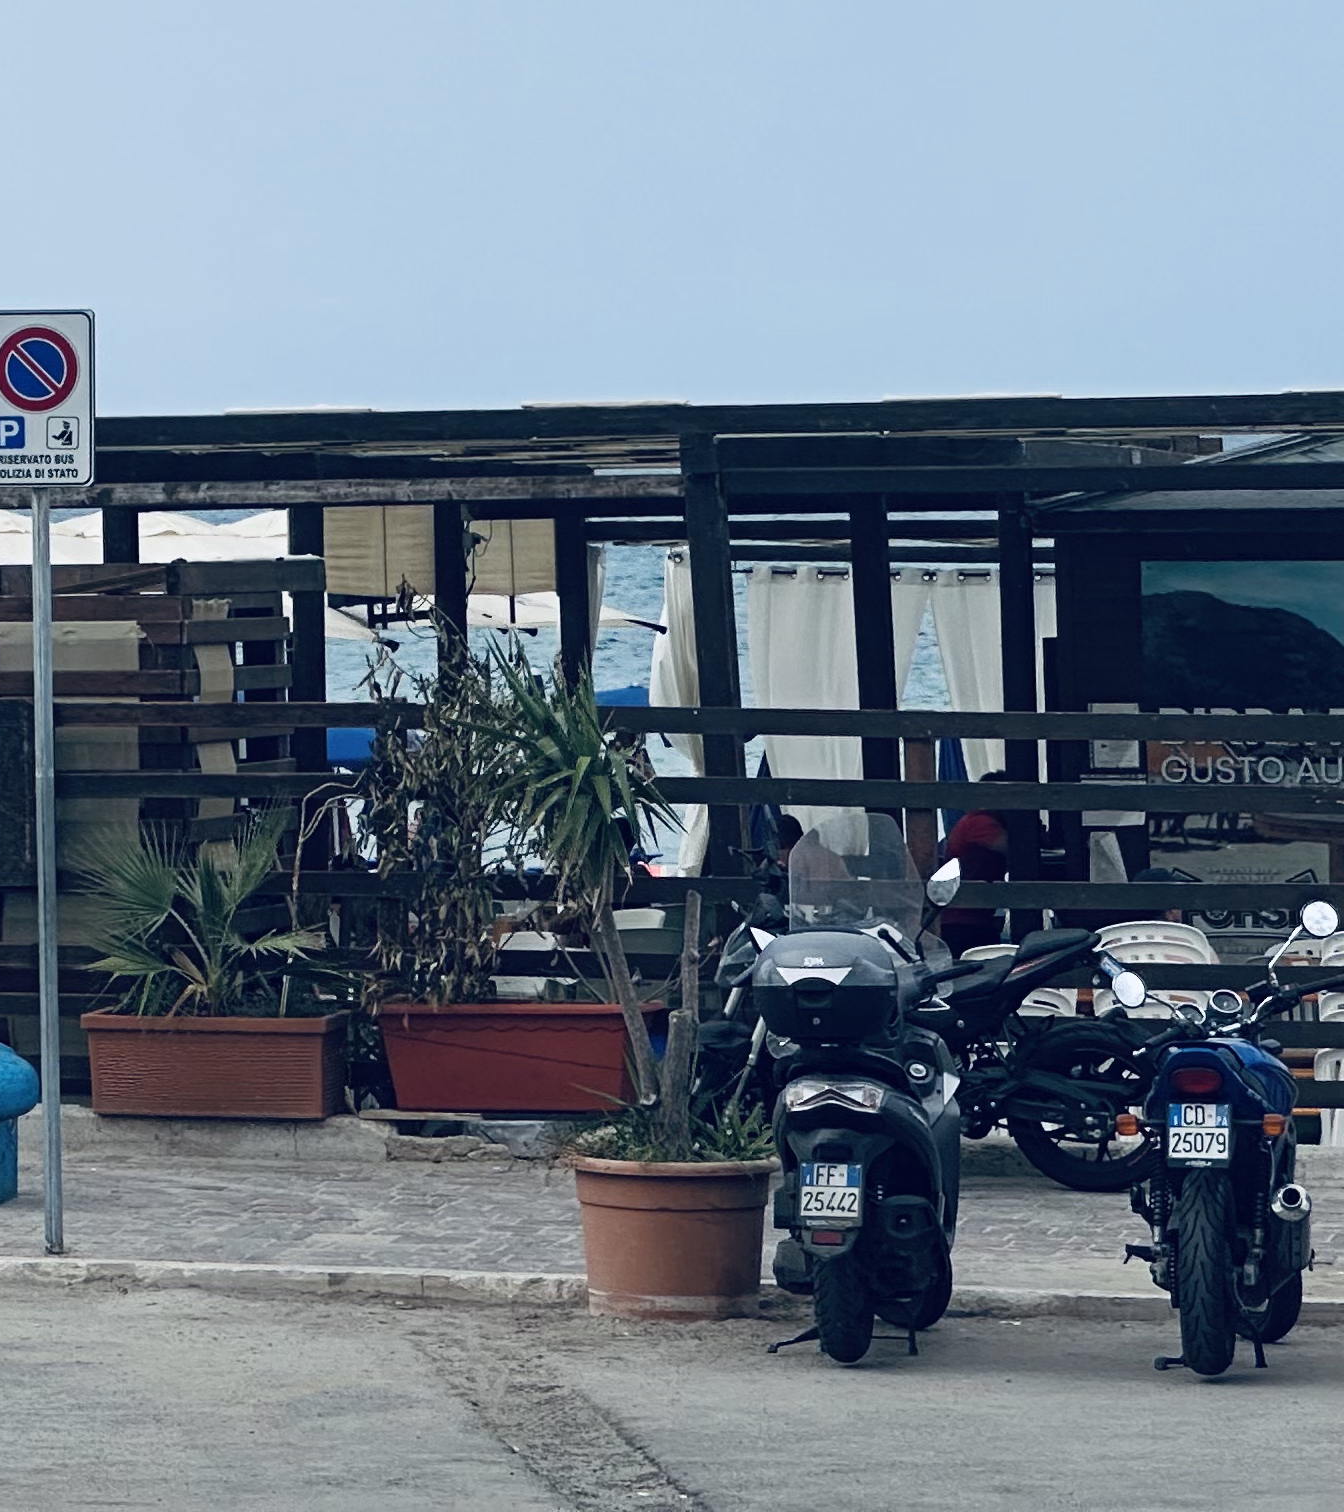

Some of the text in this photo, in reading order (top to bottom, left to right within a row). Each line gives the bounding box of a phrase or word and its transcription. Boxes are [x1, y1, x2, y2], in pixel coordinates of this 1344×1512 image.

[54, 454, 74, 464] BUS
[34, 468, 45, 479] DI
[47, 468, 79, 479] STATO
[1162, 755, 1344, 784] GUSTO AU
[1184, 1105, 1205, 1126] CD
[1172, 1132, 1226, 1154] 25079
[816, 1164, 838, 1185] FF
[803, 1191, 858, 1213] 25442
